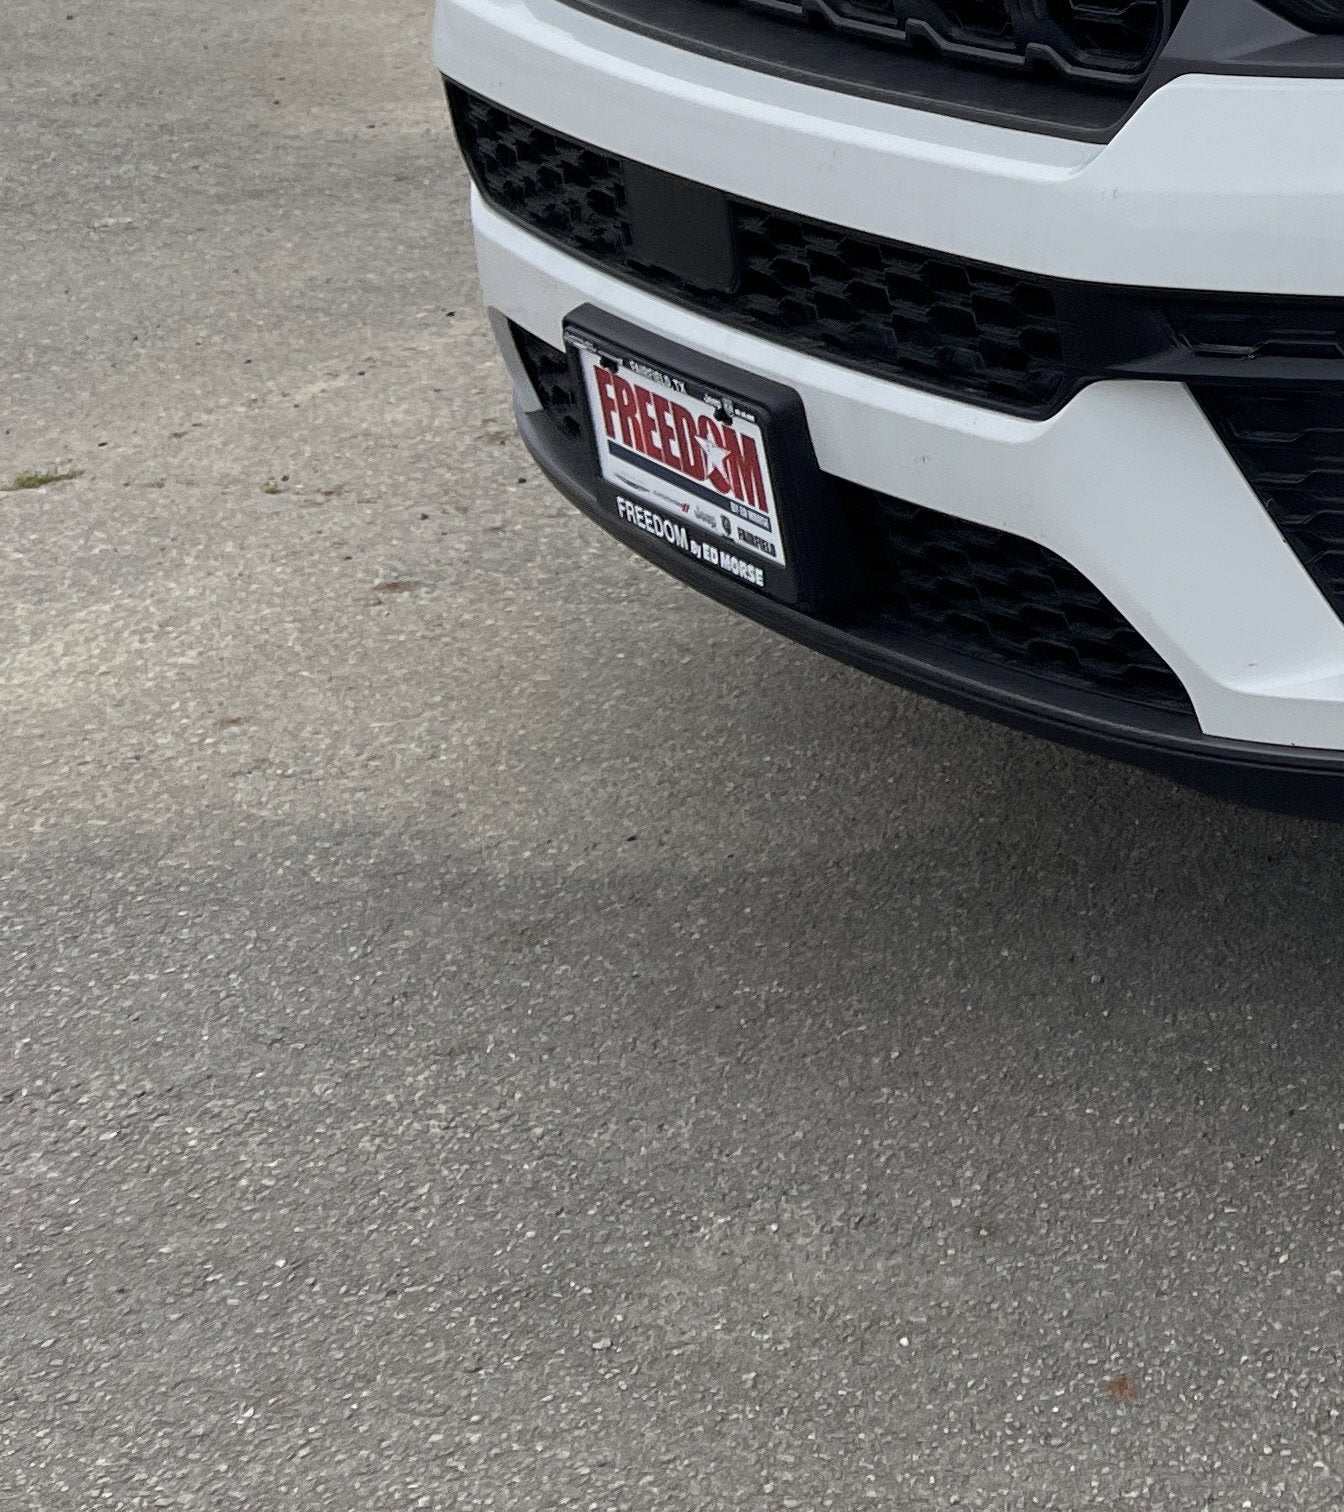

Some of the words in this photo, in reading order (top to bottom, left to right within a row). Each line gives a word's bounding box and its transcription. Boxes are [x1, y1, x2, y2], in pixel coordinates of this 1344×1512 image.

[594, 365, 768, 512] FREEDOM
[616, 495, 689, 551] FREEDOM
[690, 540, 701, 559] by
[702, 542, 719, 565] ED
[719, 550, 765, 587] MORSE
